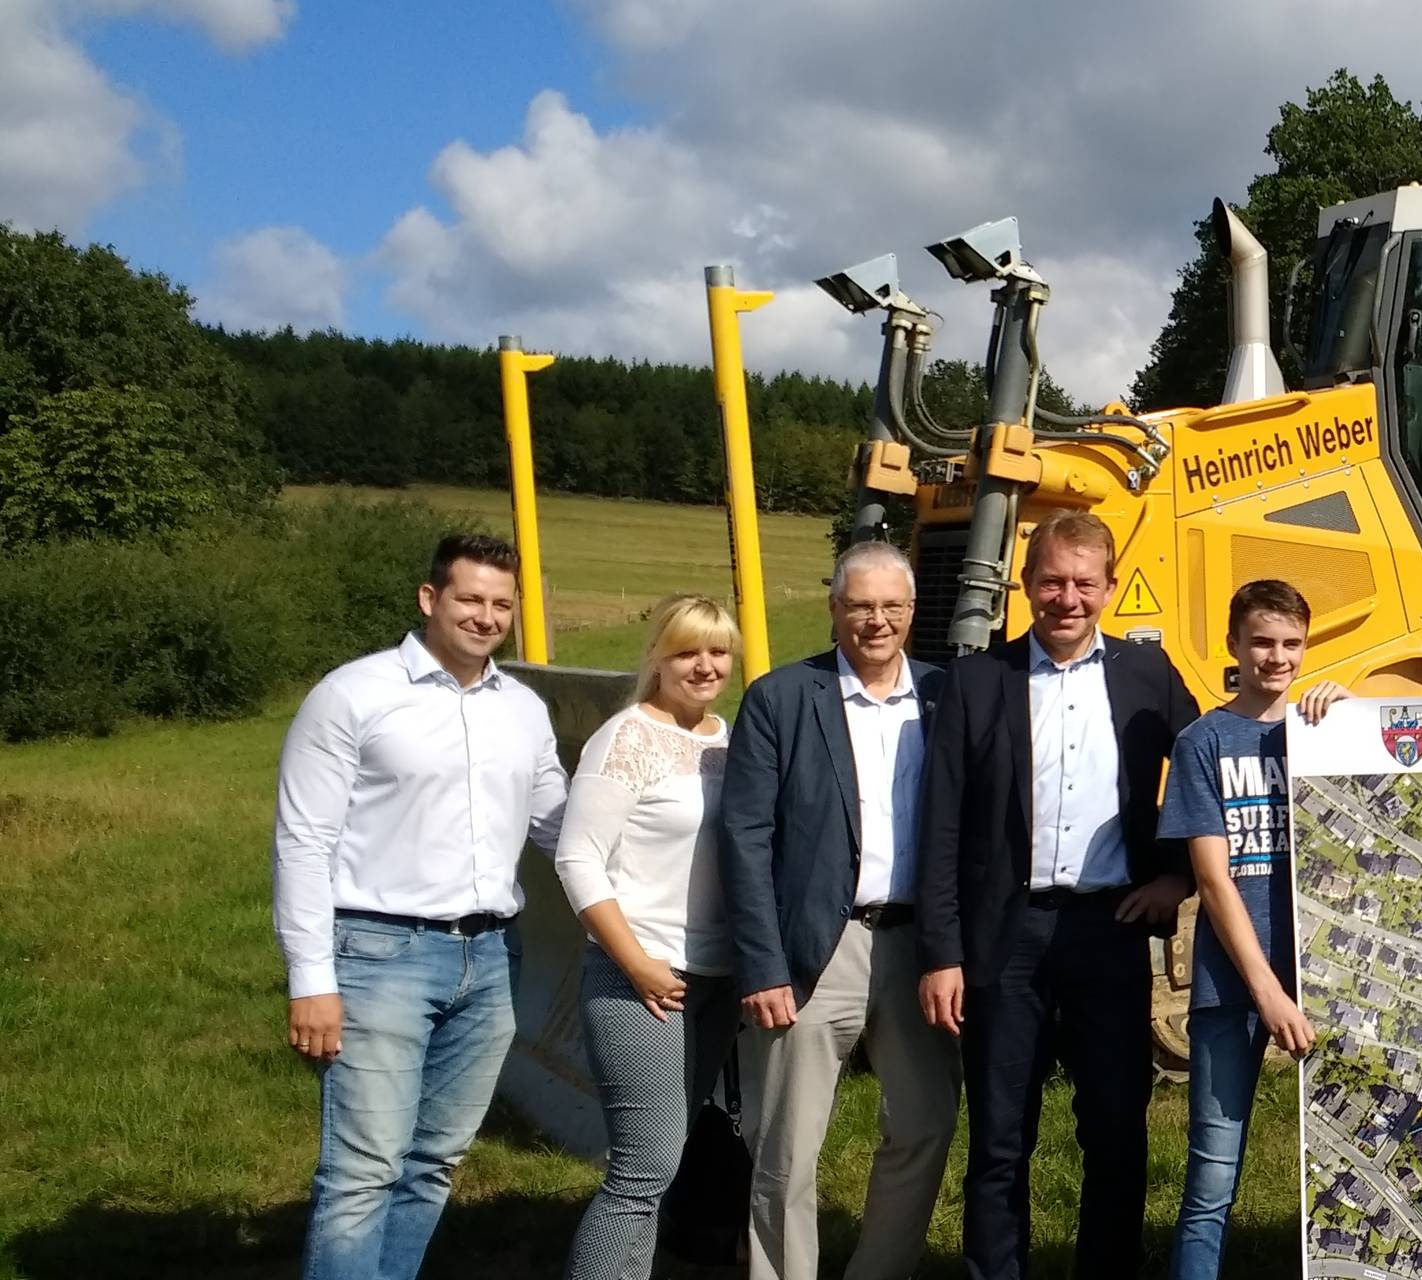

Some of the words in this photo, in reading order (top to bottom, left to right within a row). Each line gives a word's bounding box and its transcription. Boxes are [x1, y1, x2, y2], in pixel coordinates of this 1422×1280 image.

[1183, 433, 1294, 493] Heinrich
[1296, 416, 1373, 460] Weber
[1226, 804, 1288, 832] SURF
[1228, 830, 1289, 856] PARA
[1230, 863, 1273, 878] FLORIDA
